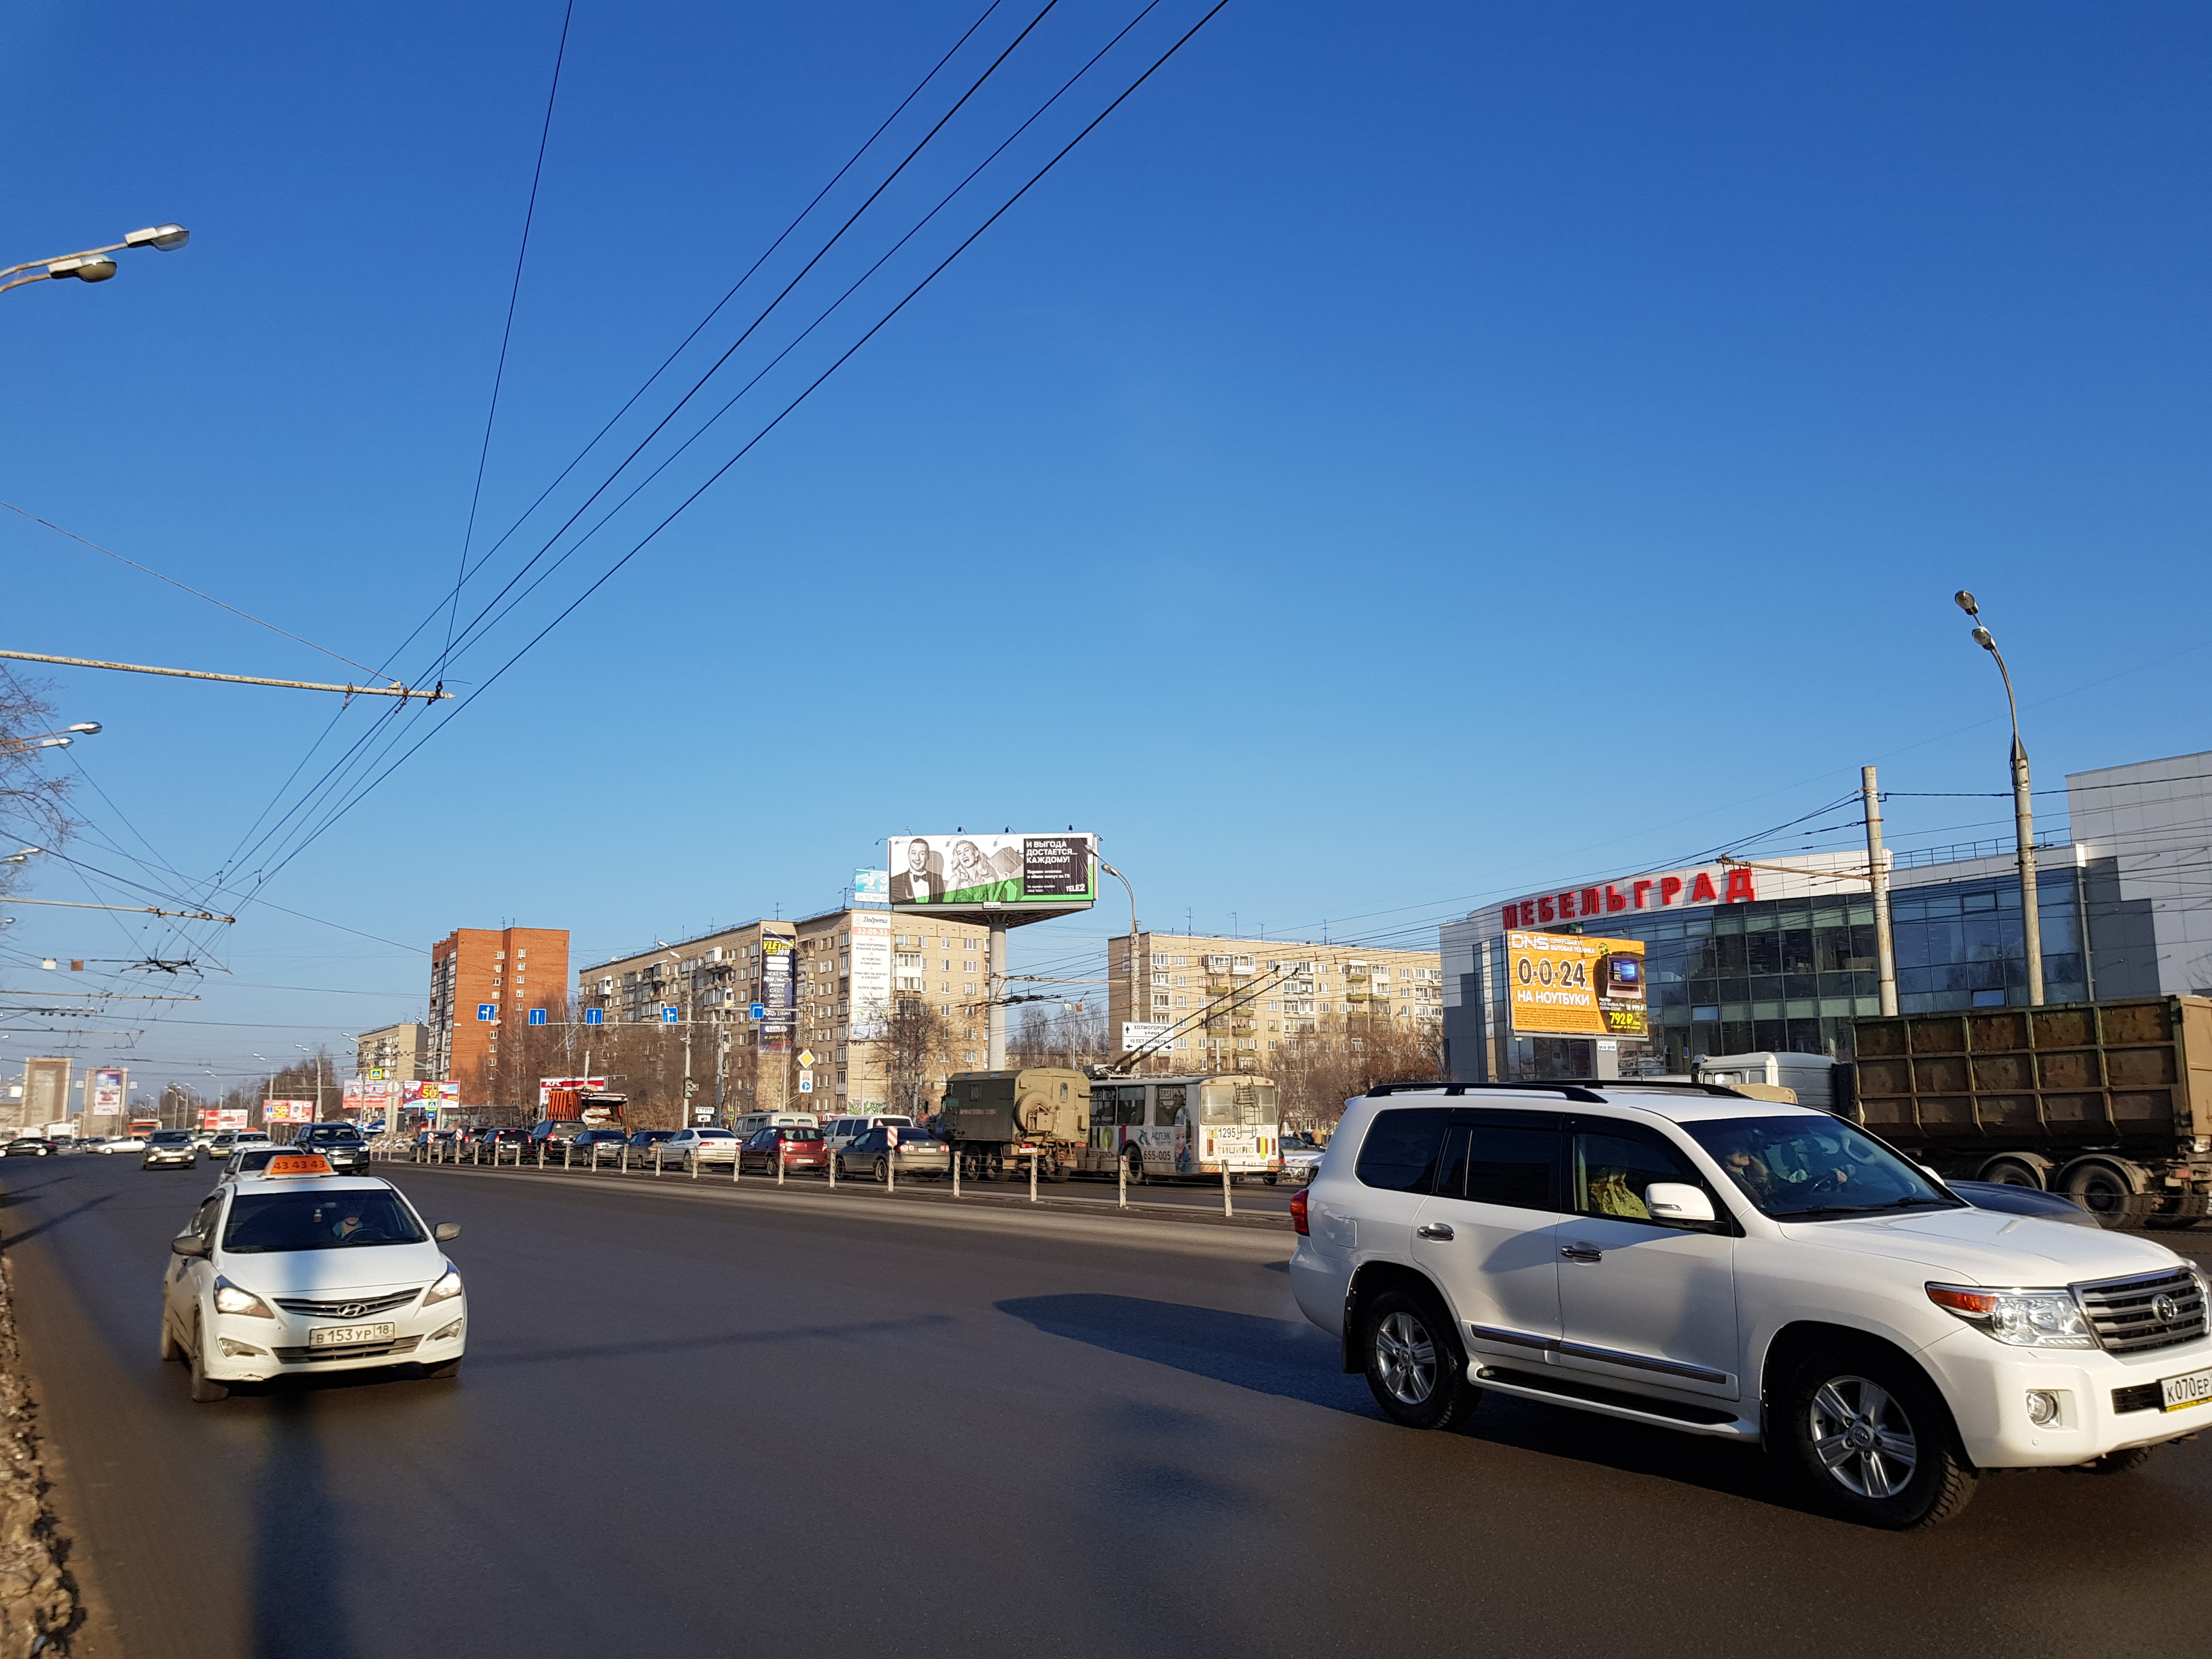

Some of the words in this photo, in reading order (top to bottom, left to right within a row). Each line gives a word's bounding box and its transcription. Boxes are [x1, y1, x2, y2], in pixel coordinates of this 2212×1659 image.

[1502, 868, 1754, 929] МЕБЕЛЬГРАД
[857, 928, 888, 936] 32-09-33
[1512, 934, 1549, 950] DNS
[1517, 990, 1533, 1003] НА
[1536, 991, 1590, 1006] НОУТБУКИ
[1152, 1132, 1171, 1140] АСПЭК
[1218, 1127, 1235, 1138] 1295
[1143, 1150, 1171, 1161] 655-005
[292, 1161, 307, 1169] 43
[311, 1160, 326, 1168] 43
[376, 1325, 389, 1335] 18
